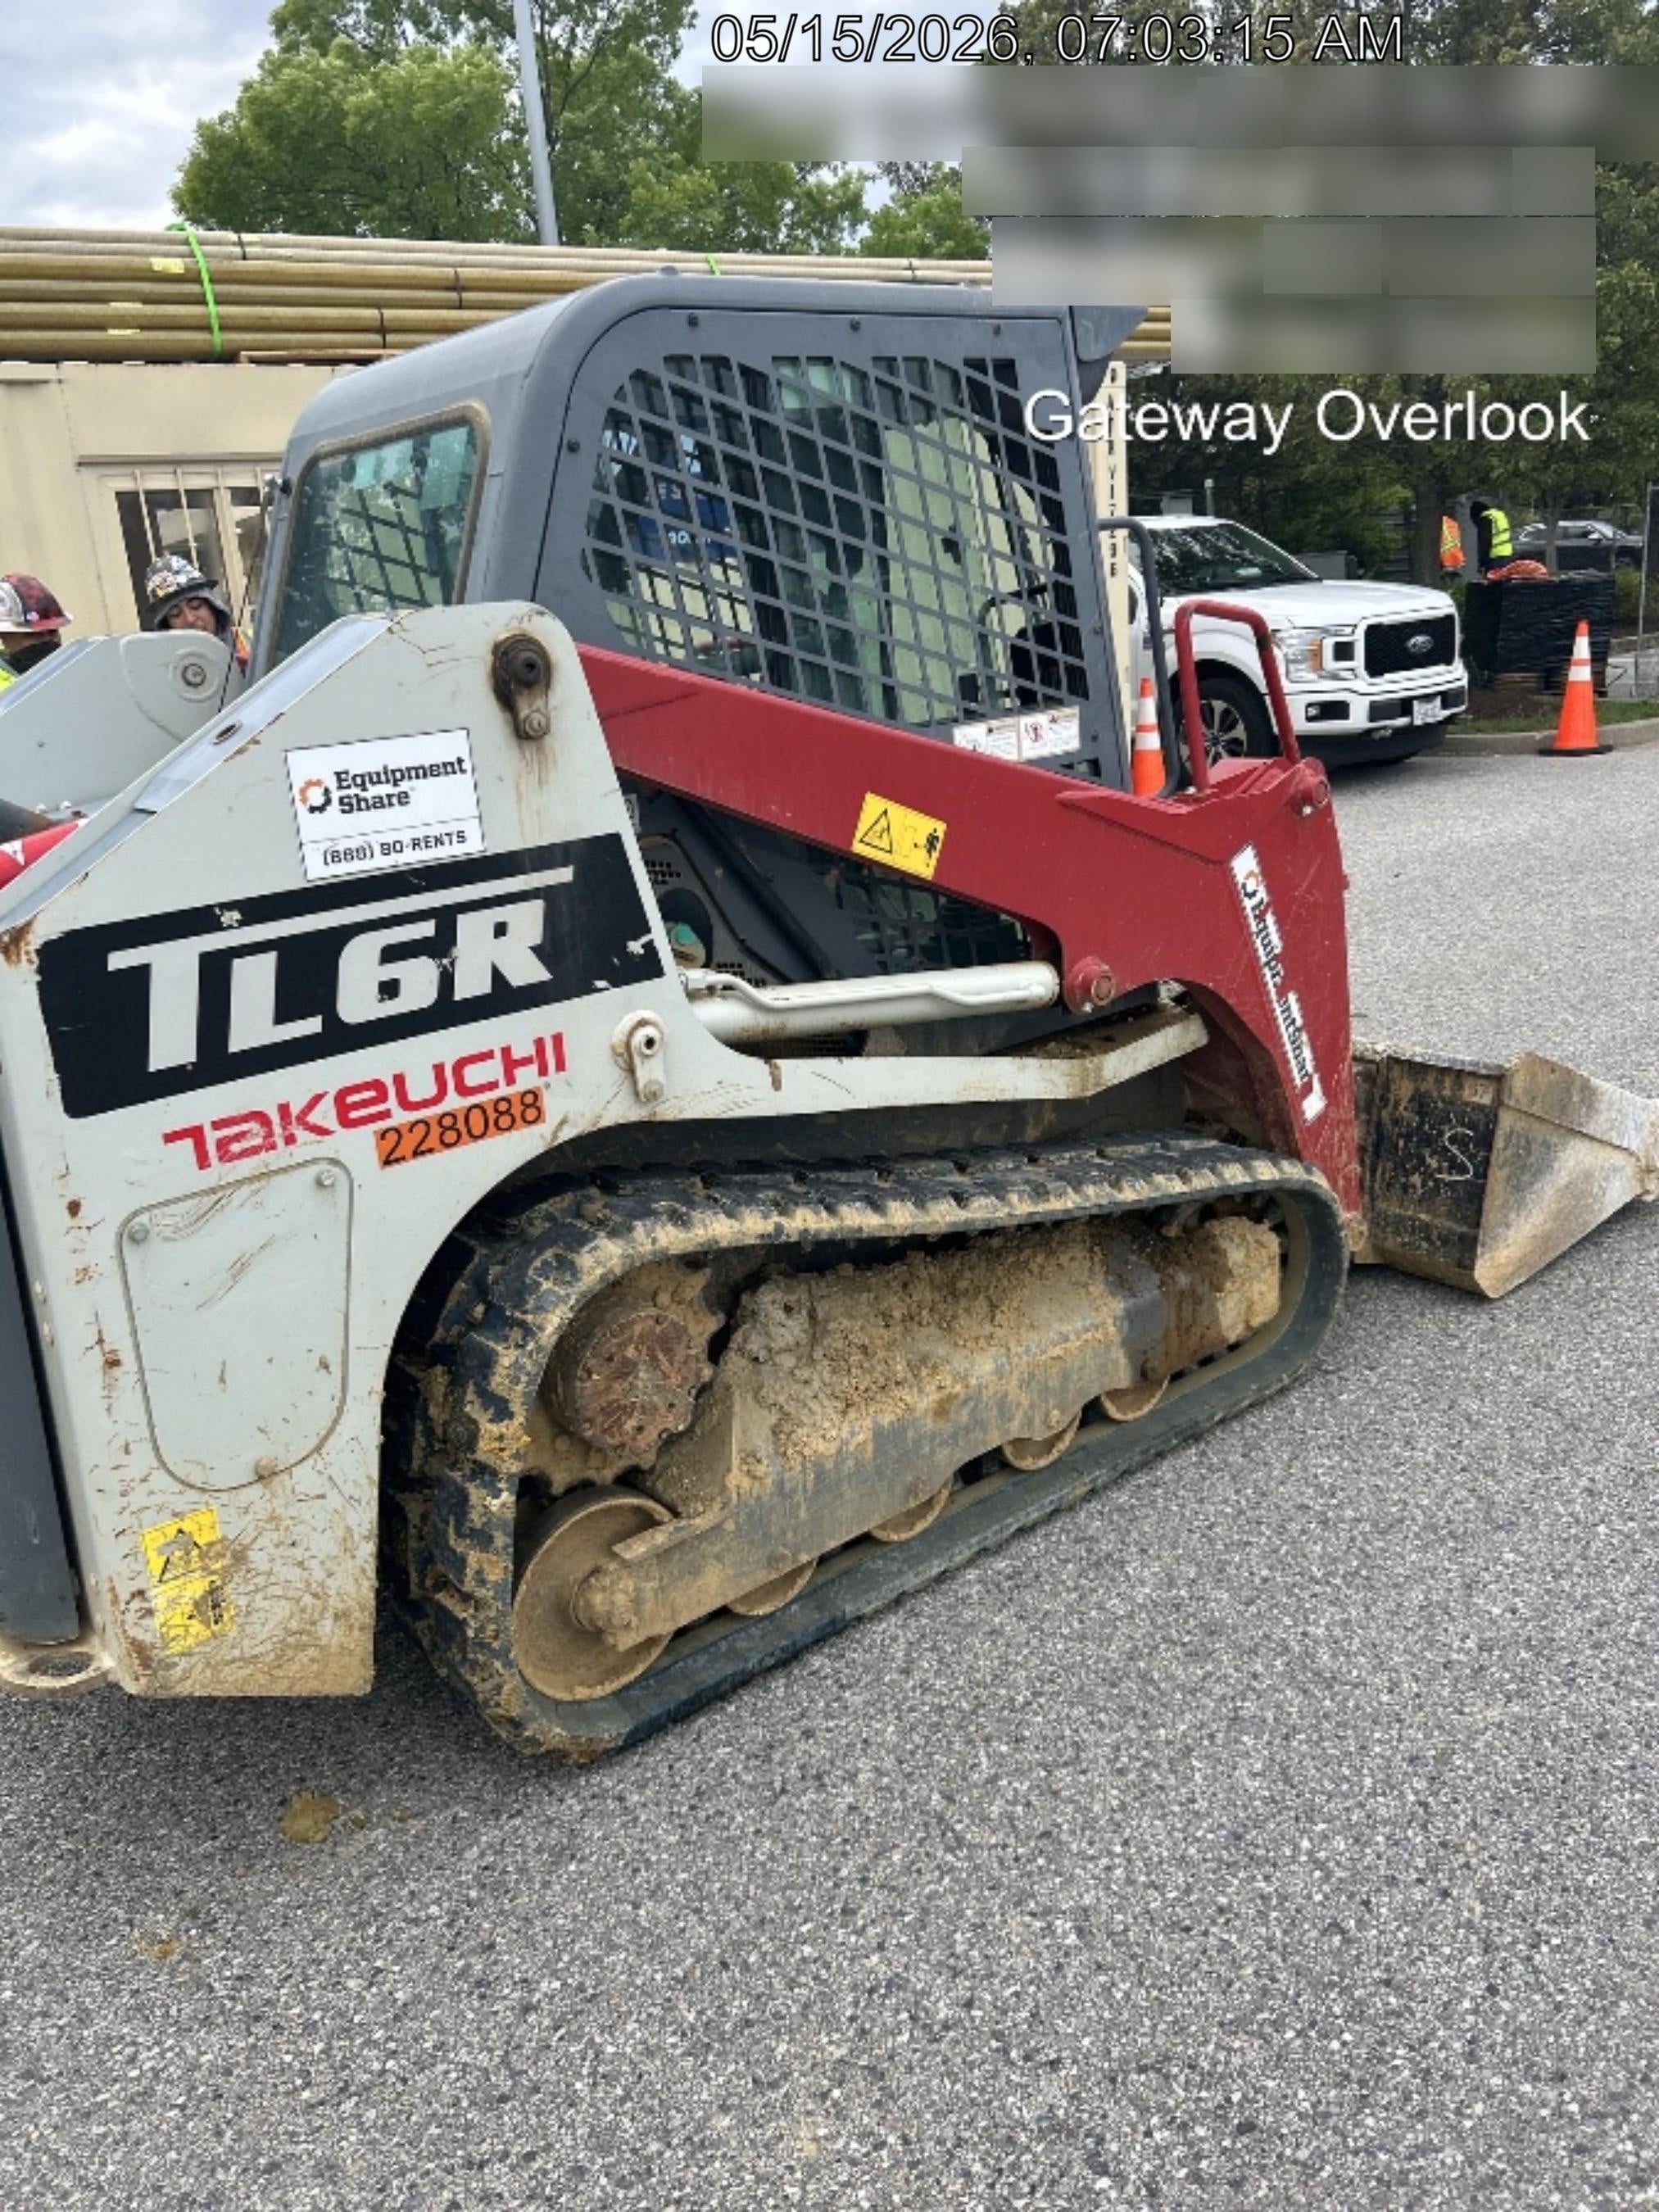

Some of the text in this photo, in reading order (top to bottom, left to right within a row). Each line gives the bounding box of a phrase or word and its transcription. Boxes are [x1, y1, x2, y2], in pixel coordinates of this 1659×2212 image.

[333, 756, 467, 791] Equipment
[338, 790, 411, 814] Share
[107, 866, 573, 1072] TL6R
[378, 1091, 544, 1167] 228088
